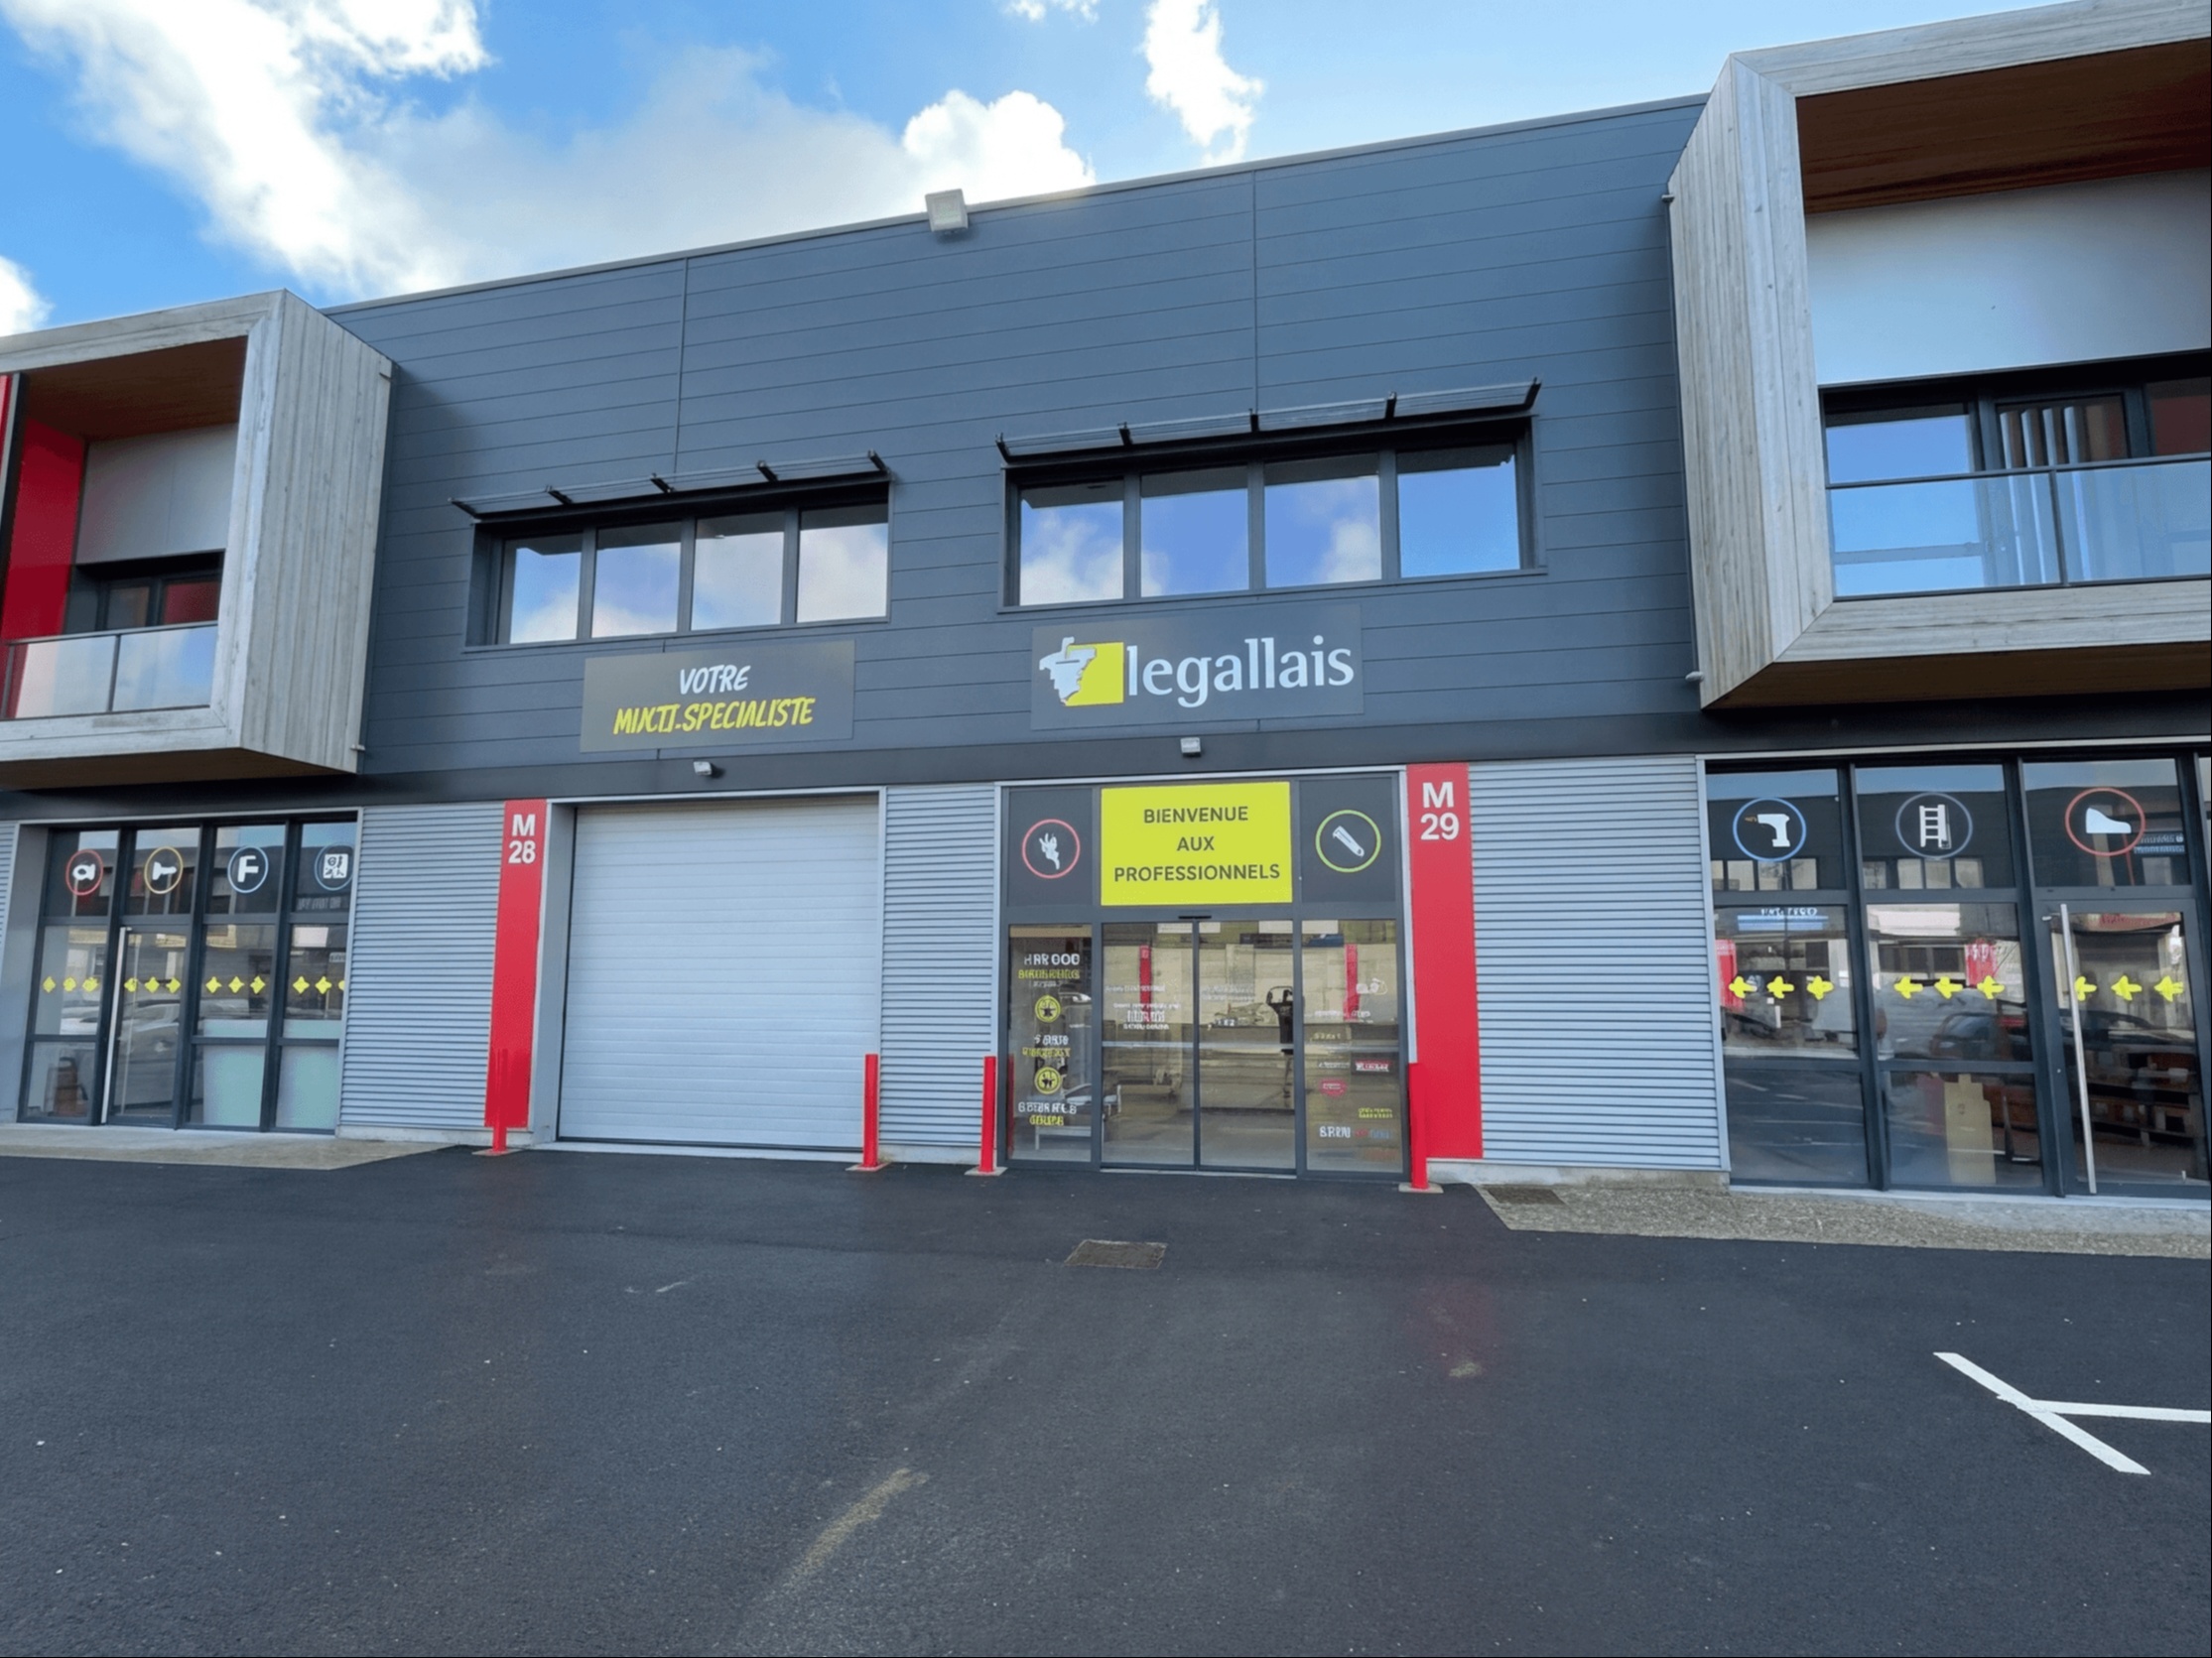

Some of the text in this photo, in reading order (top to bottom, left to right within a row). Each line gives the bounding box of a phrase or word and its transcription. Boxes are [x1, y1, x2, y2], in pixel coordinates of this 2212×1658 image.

[680, 665, 751, 695] VOTRE
[1127, 635, 1355, 707] legallais
[1422, 781, 1455, 809] M
[511, 814, 536, 836] M
[1143, 806, 1248, 824] BIENVENUE
[1420, 812, 1460, 840] 29
[508, 839, 536, 864] 28
[1176, 835, 1215, 852] AUX
[1114, 863, 1280, 882] PROFESSIONNELS
